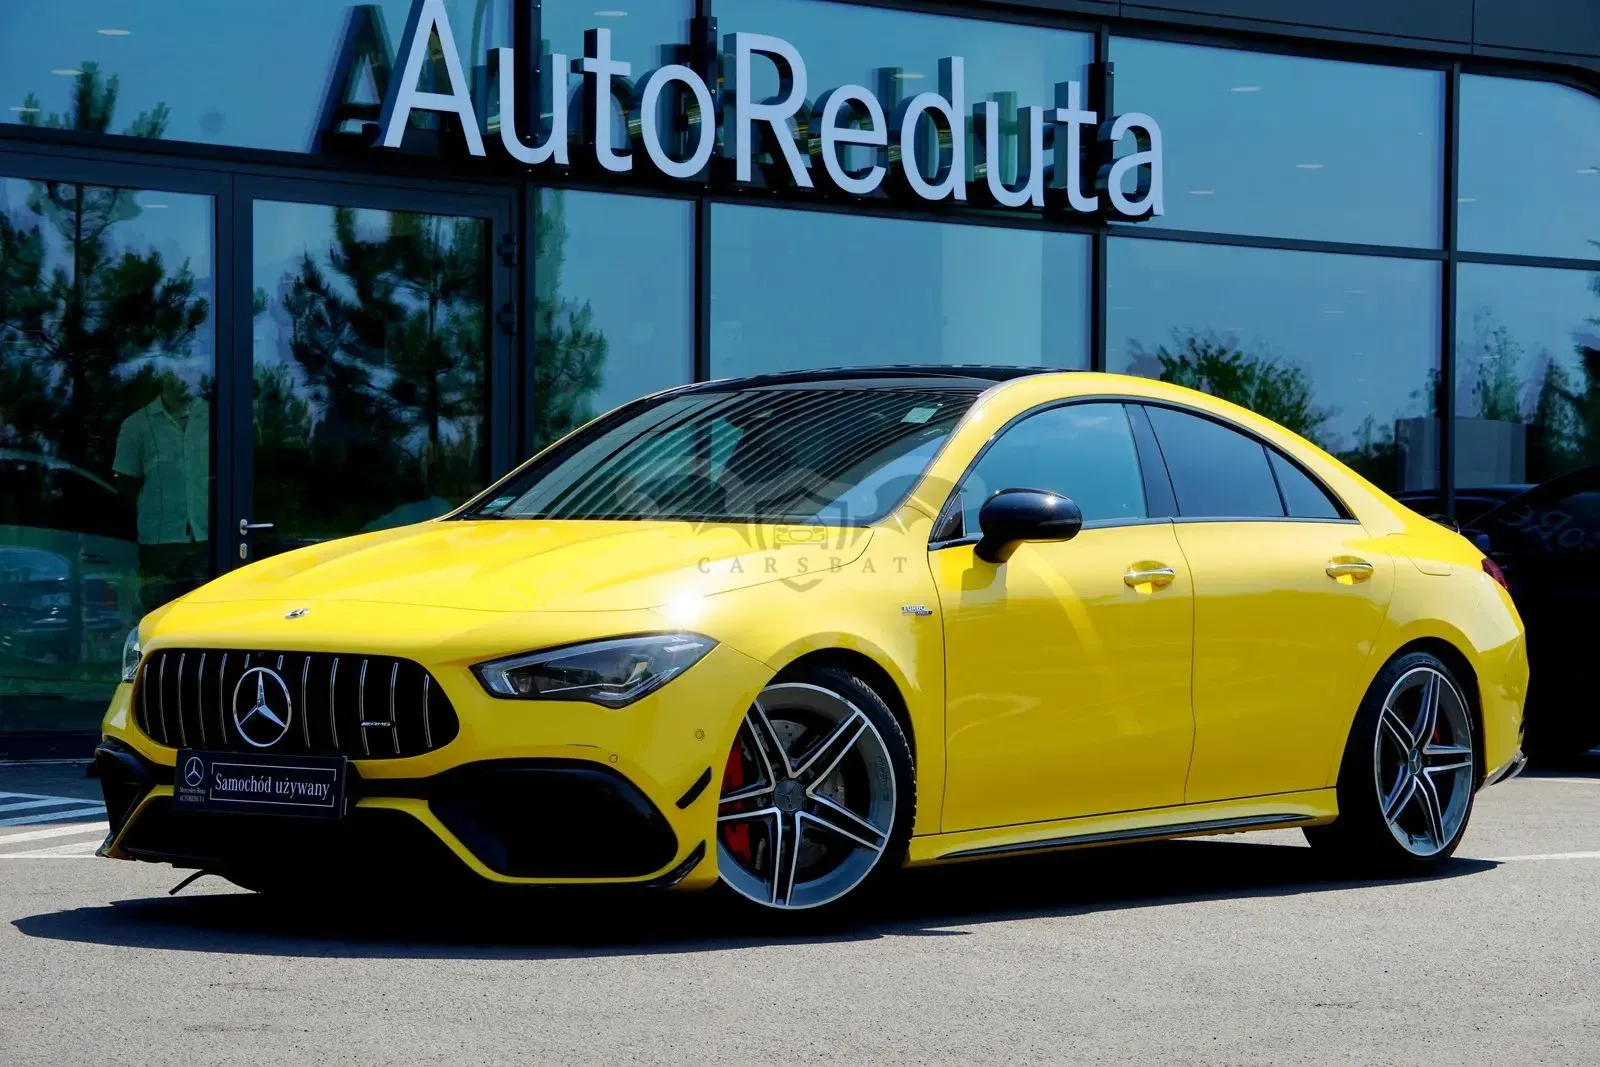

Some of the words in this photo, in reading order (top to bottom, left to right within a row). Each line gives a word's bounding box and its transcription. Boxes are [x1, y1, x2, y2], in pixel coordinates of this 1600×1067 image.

[383, 0, 1164, 217] AutoReduta
[215, 772, 272, 793] Samochód
[275, 777, 331, 800] używany
